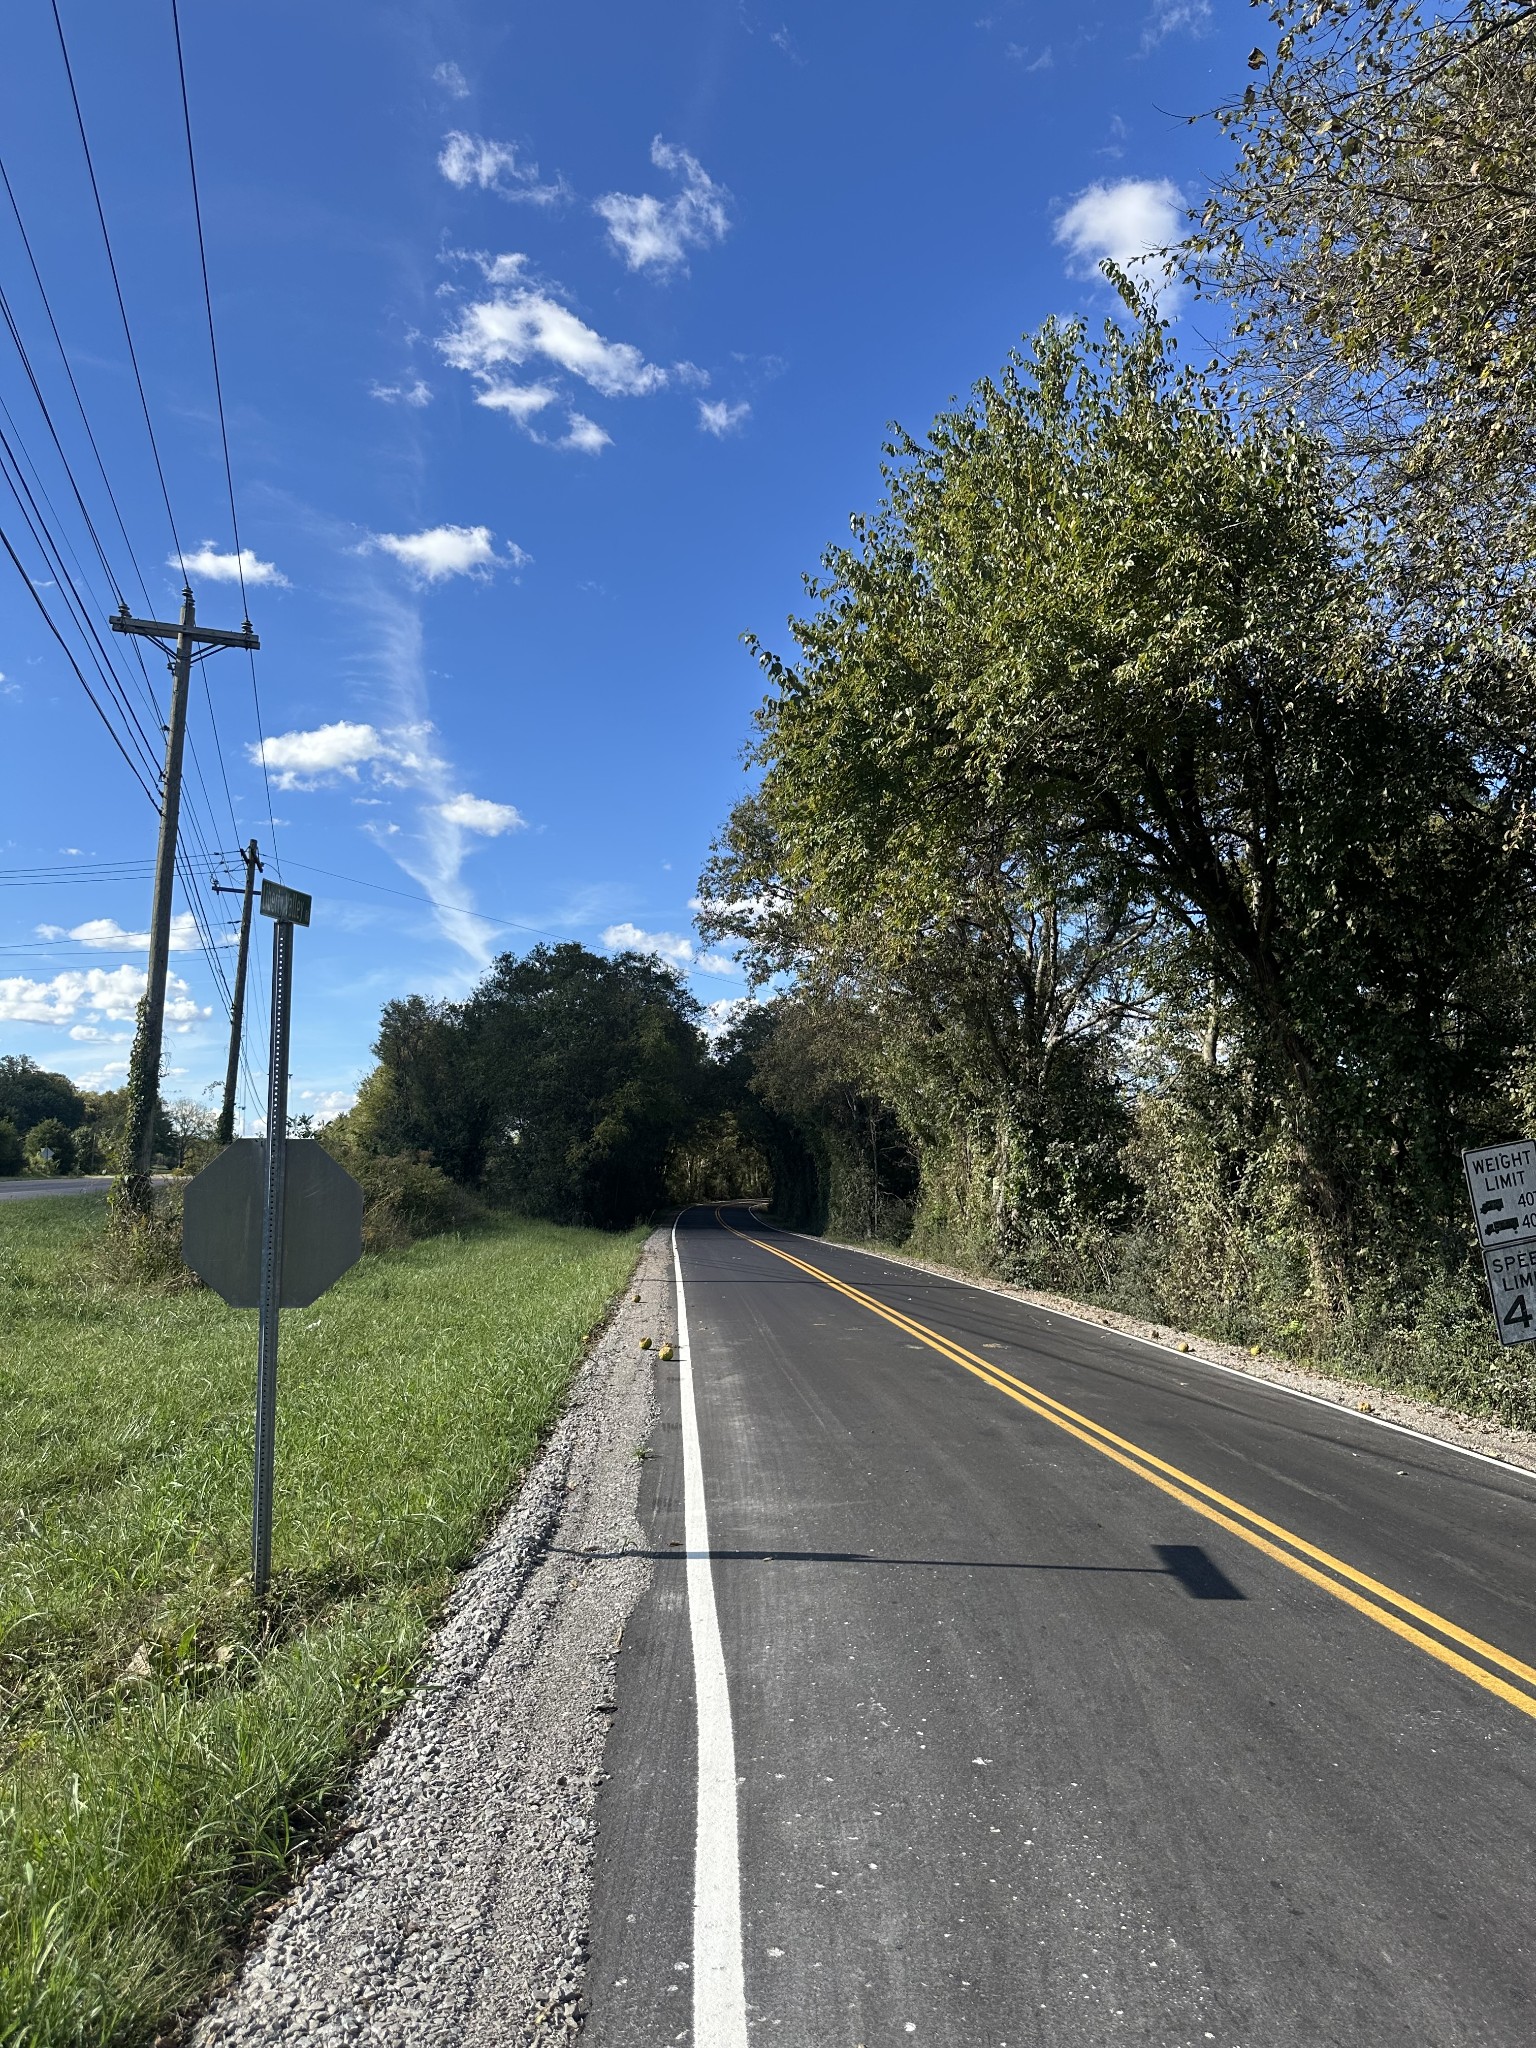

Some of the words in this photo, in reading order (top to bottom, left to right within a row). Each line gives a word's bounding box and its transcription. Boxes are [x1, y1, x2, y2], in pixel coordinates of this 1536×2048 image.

[1472, 1150, 1530, 1174] WEIGHT
[1485, 1171, 1524, 1191] LIMIT
[1503, 1294, 1536, 1331] 4
